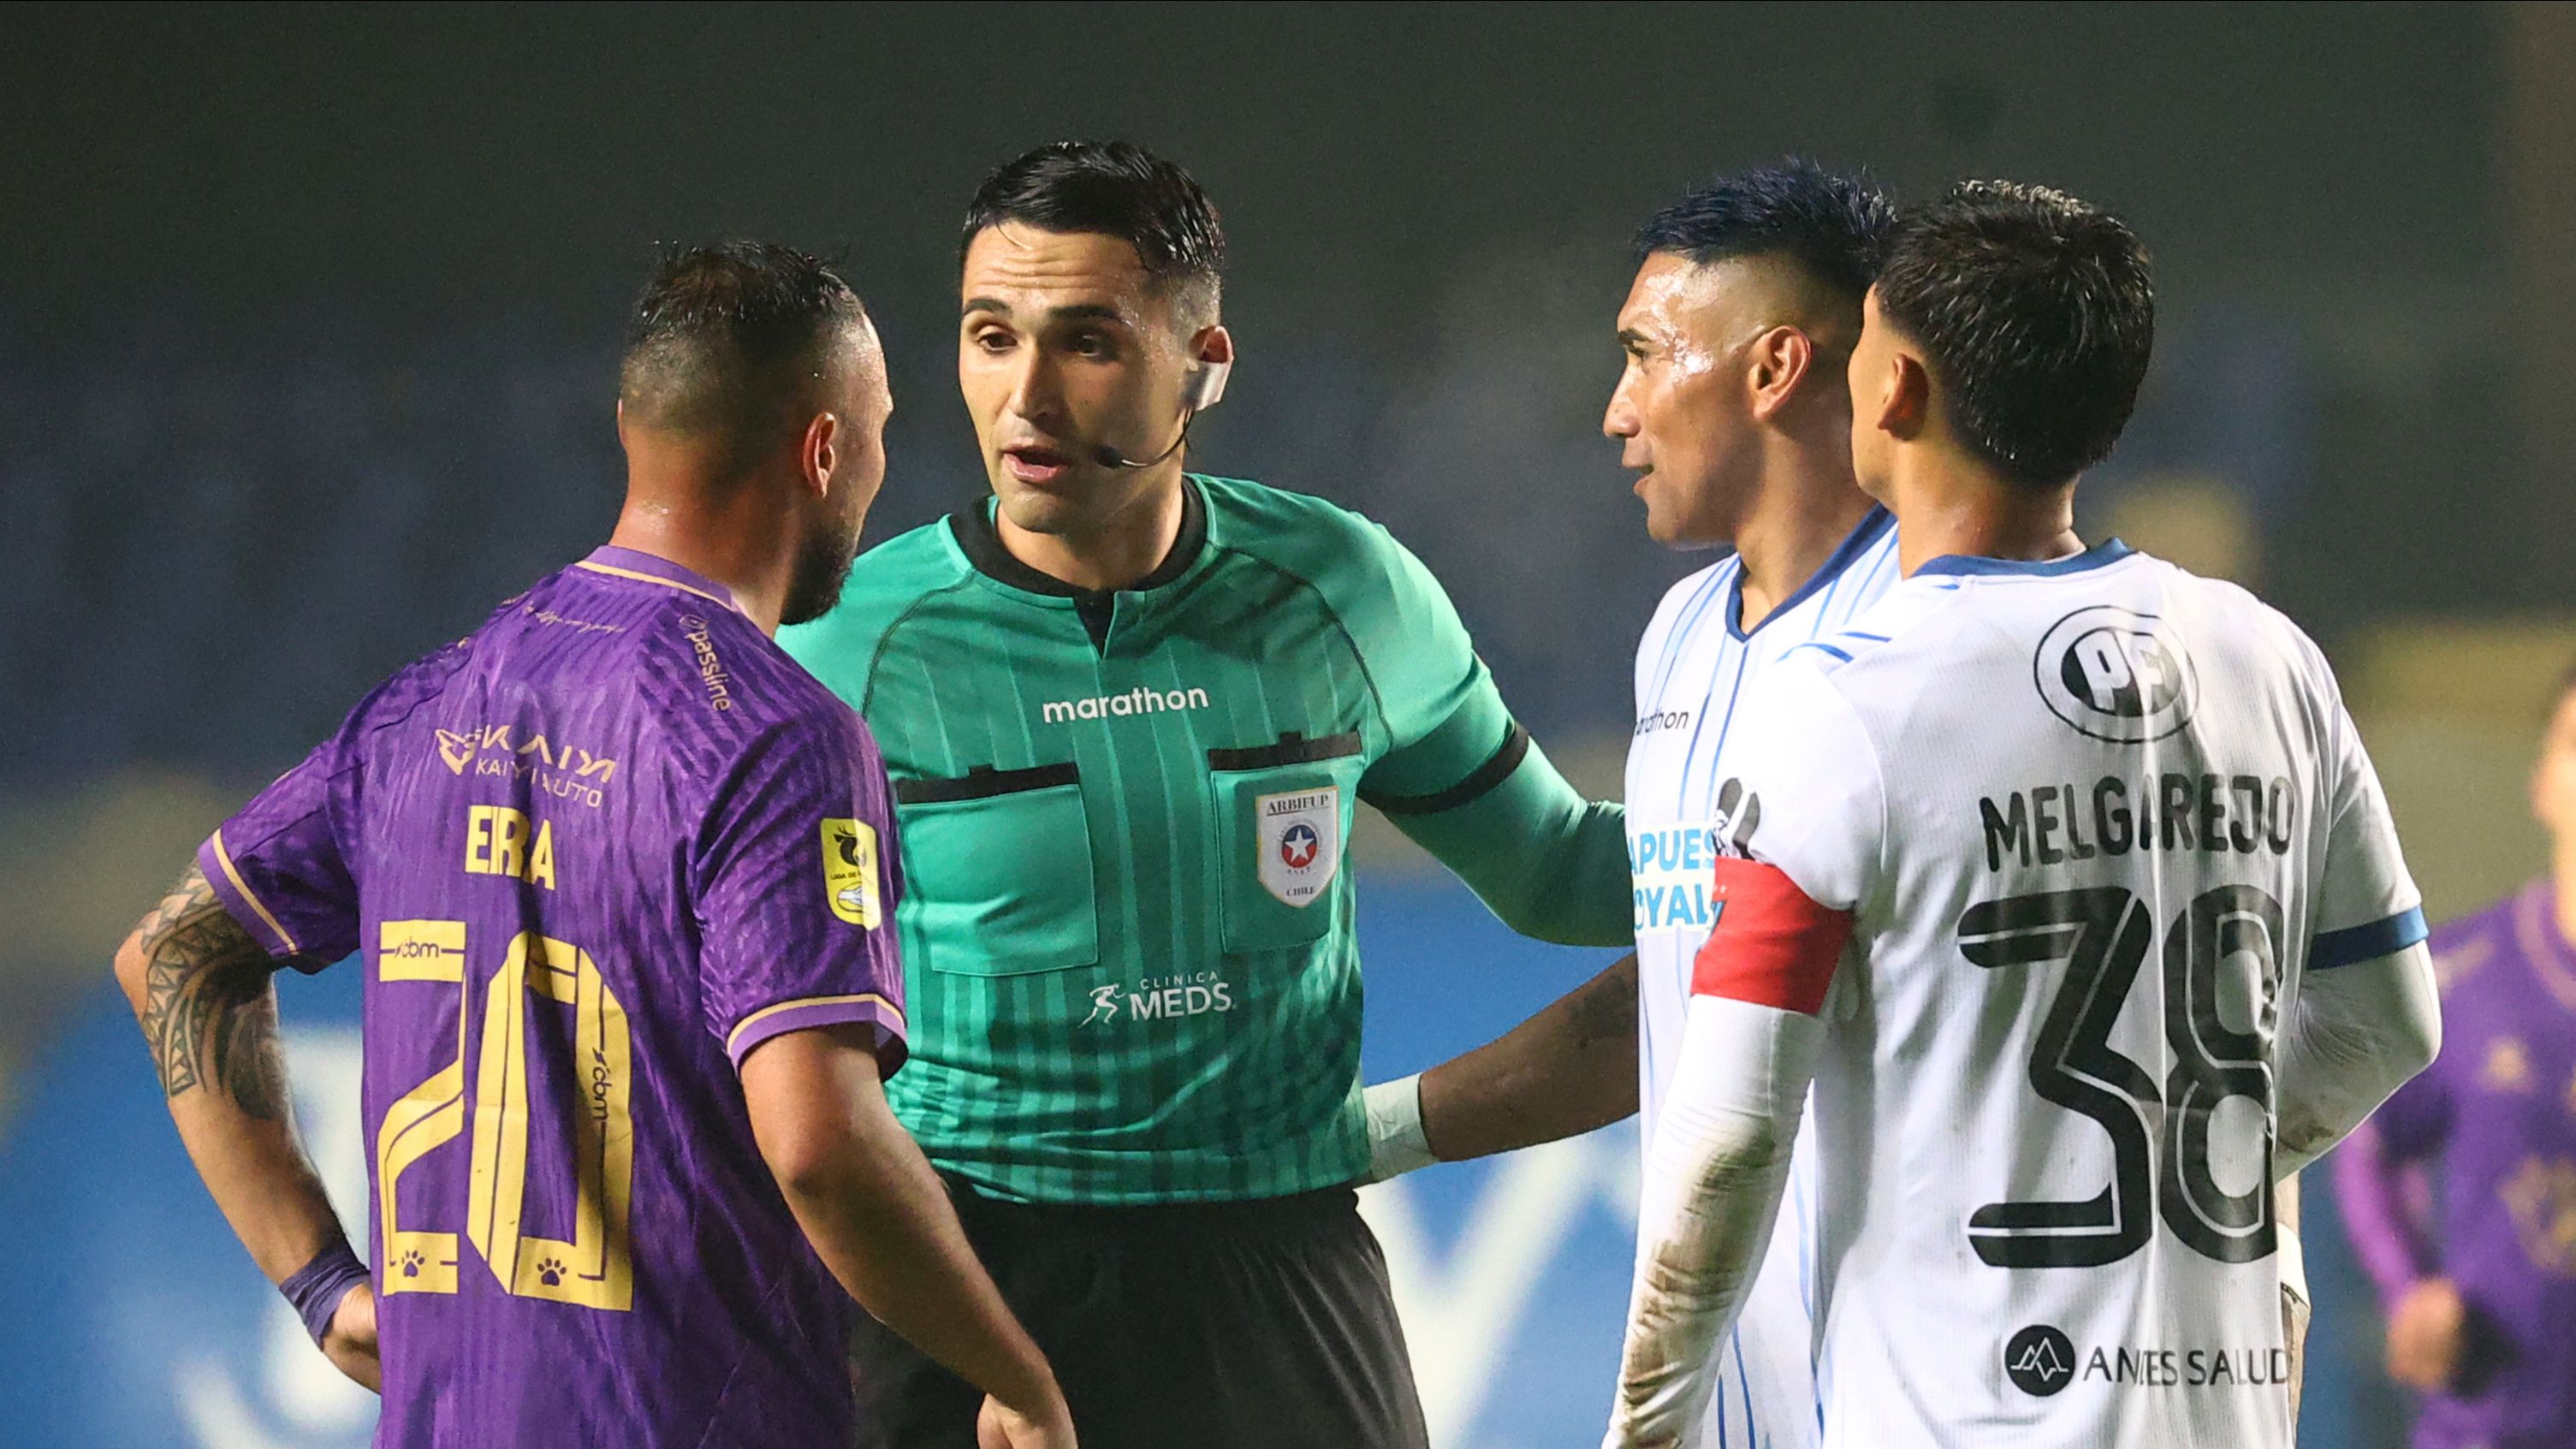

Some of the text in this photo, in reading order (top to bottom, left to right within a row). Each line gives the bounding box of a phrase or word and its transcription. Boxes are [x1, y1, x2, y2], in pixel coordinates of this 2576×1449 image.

[684, 630, 731, 712] passline
[1042, 686, 1209, 723] marathon
[1267, 793, 1329, 814] ARBIFUP
[1979, 773, 2295, 873] MELGAREJO
[1286, 886, 1315, 897] CHILE
[1634, 883, 1709, 930] OYAL
[1139, 971, 1219, 990] CLINICA
[1957, 884, 2286, 1268] 38
[377, 918, 633, 1312] 20
[2187, 1349, 2288, 1386] SALUD
